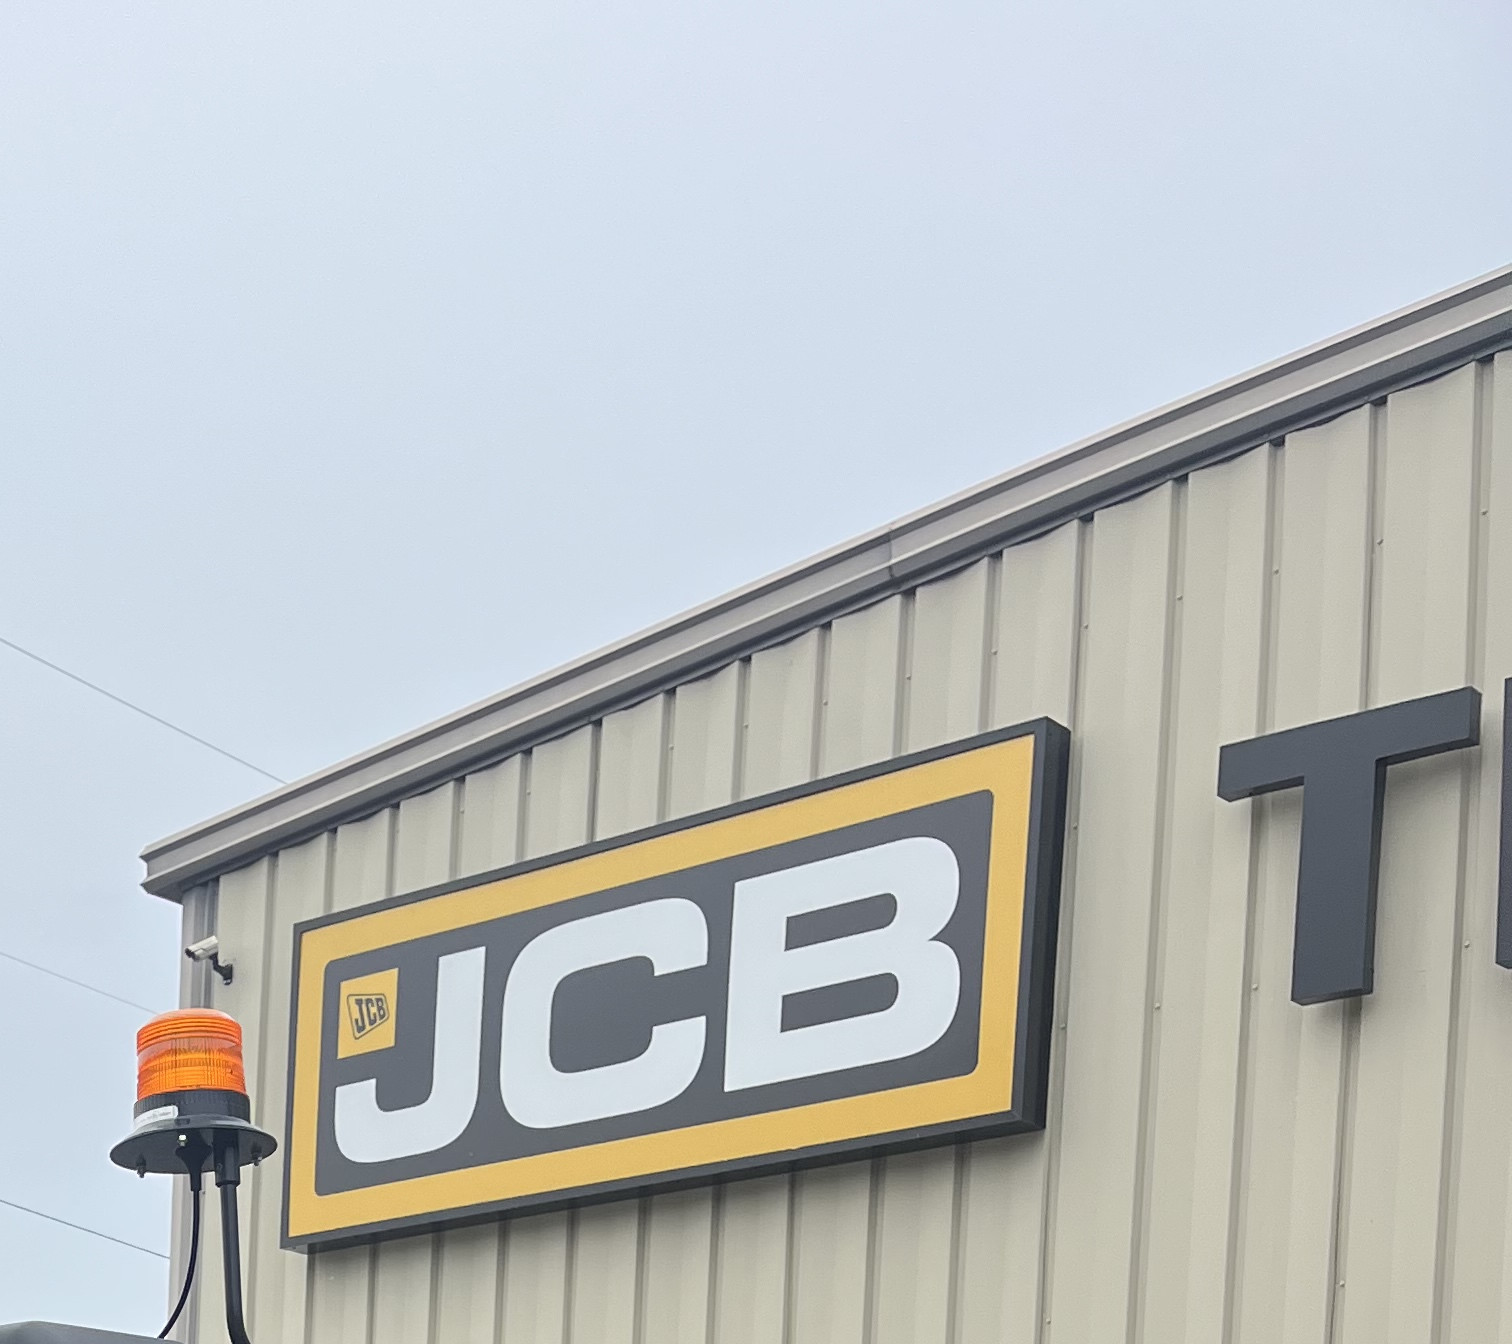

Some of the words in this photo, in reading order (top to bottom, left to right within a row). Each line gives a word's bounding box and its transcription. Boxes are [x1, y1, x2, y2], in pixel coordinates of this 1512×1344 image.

[333, 834, 961, 1164] JCB
[1217, 678, 1512, 1006] T
[354, 997, 386, 1034] JCB
